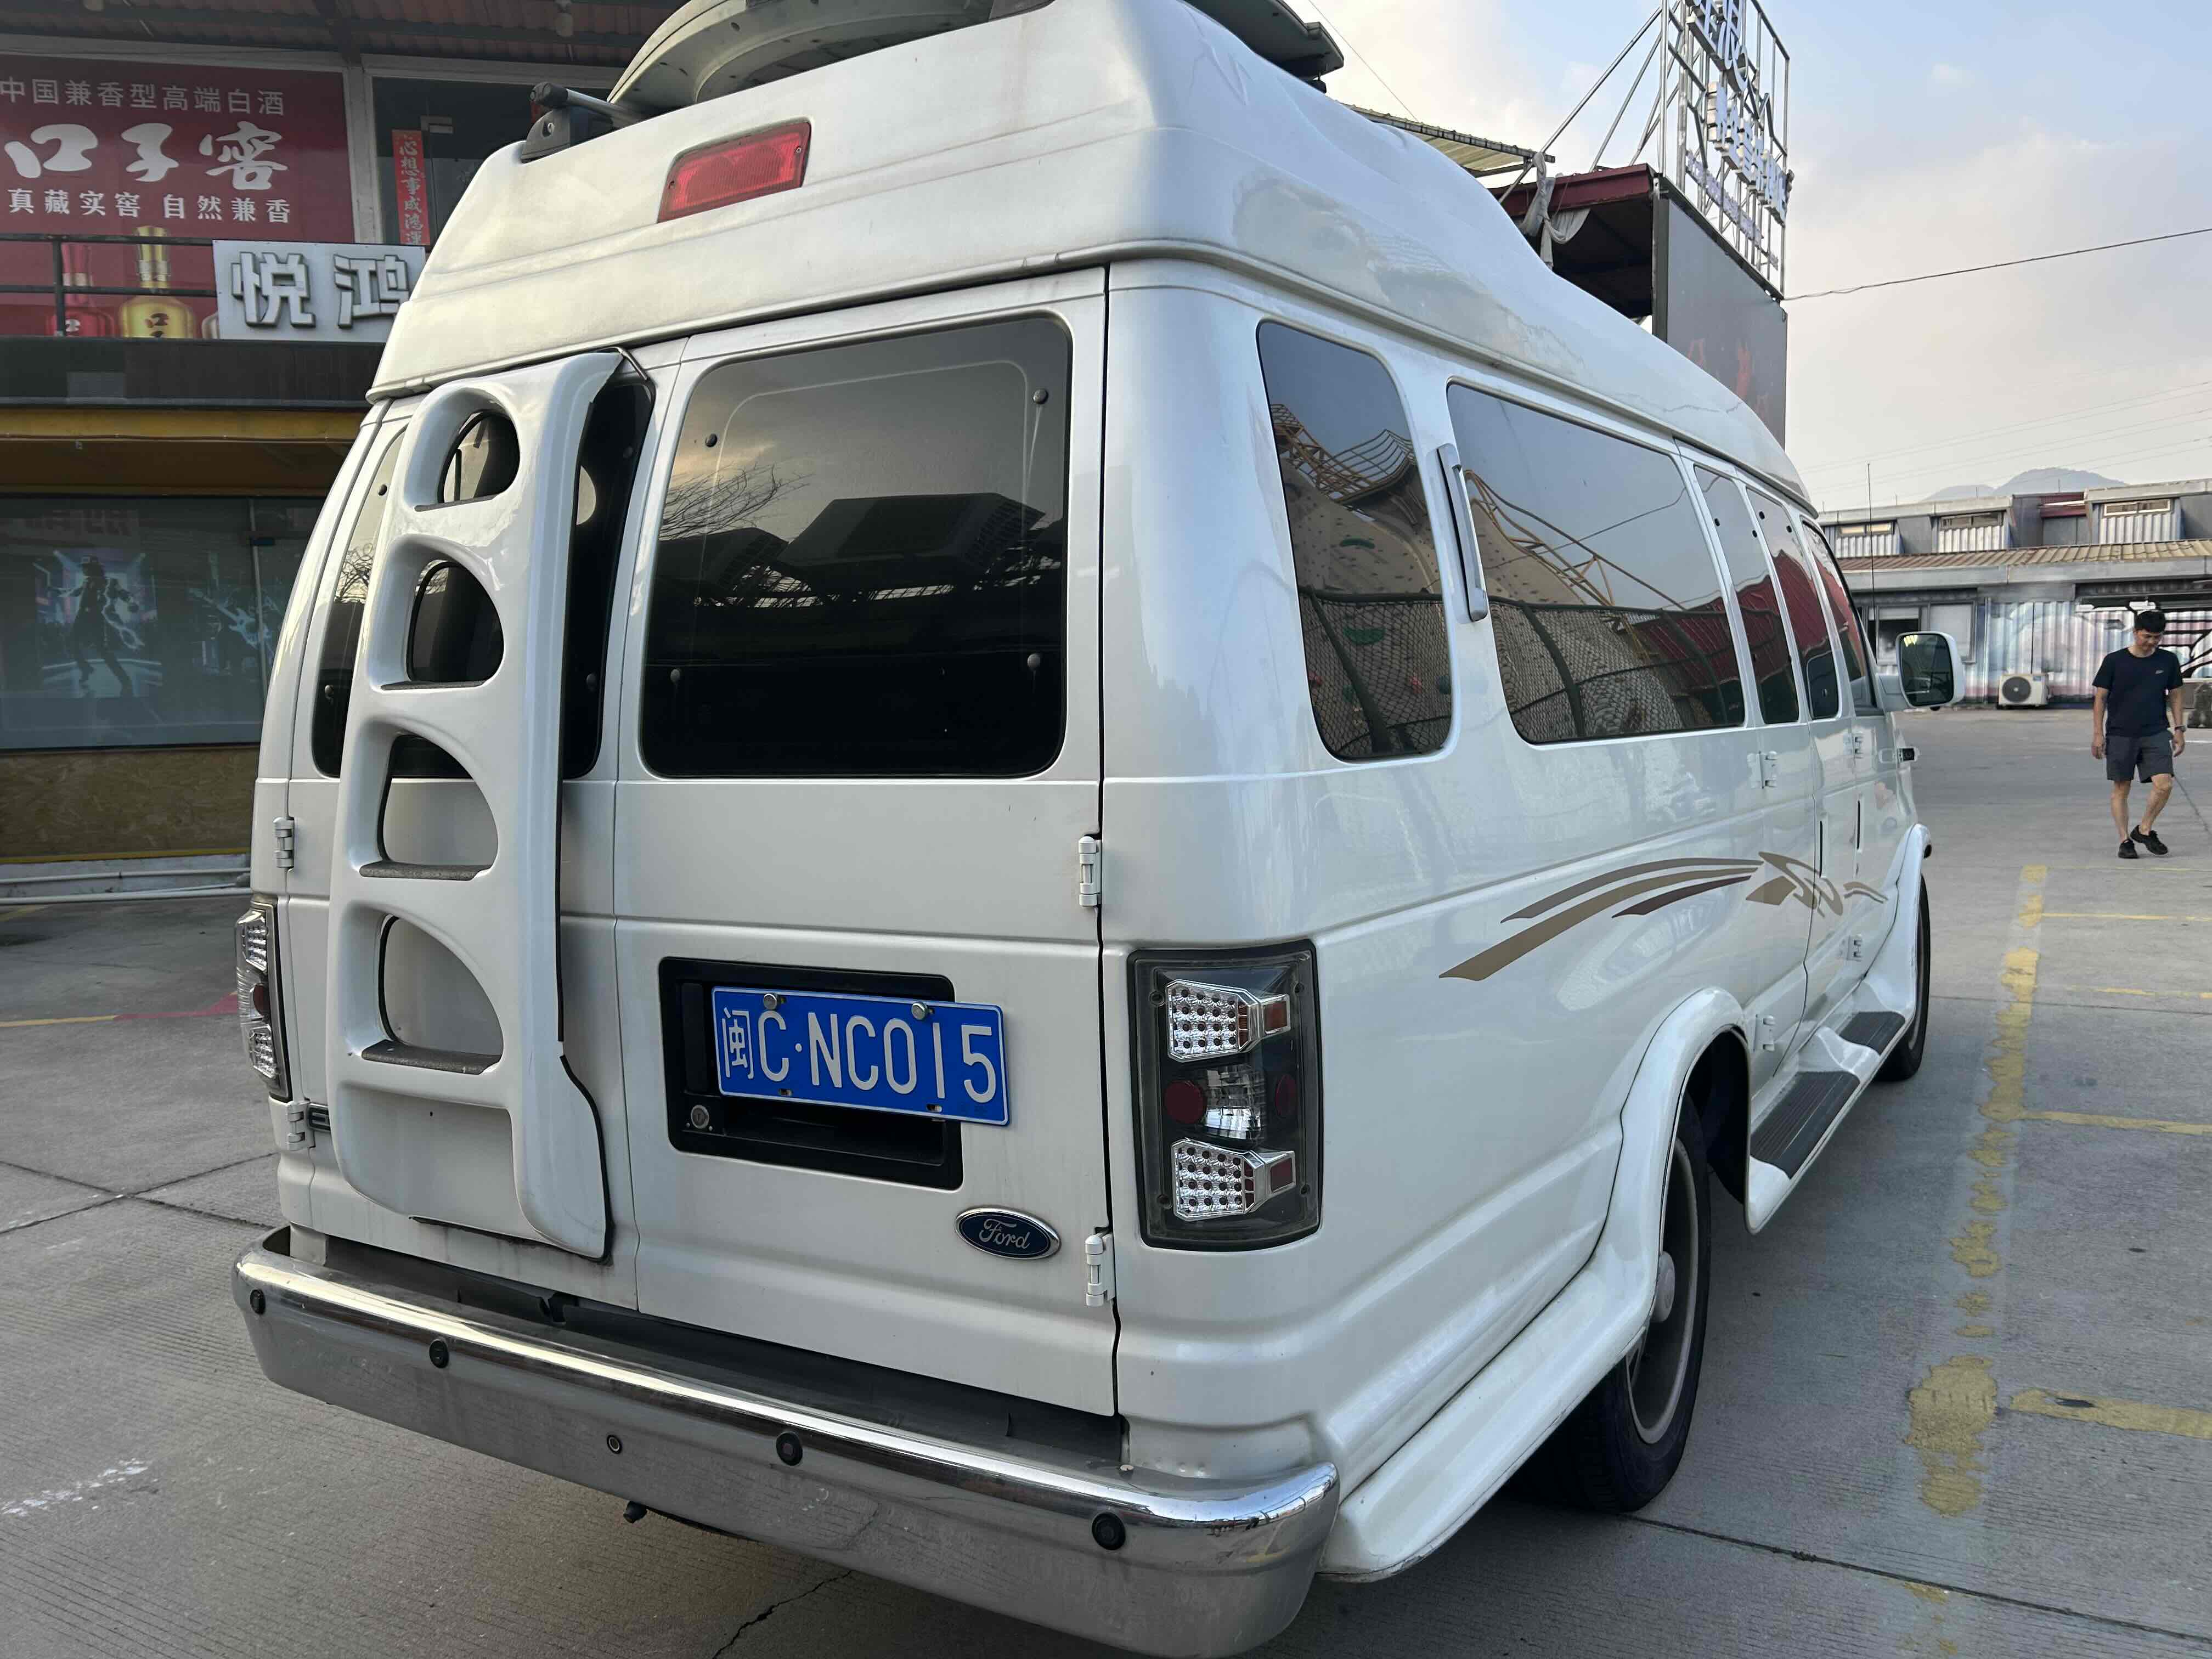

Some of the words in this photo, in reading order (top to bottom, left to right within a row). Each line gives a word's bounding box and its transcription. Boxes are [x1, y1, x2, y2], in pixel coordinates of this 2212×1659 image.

[0, 76, 284, 116] 中国兼香型高端白酒
[4, 121, 289, 190] 口子窖
[7, 188, 141, 218] 真藏实窖
[163, 194, 290, 223] 自然兼香
[230, 252, 409, 329] 悦鸿
[979, 1218, 1031, 1249] Ford
